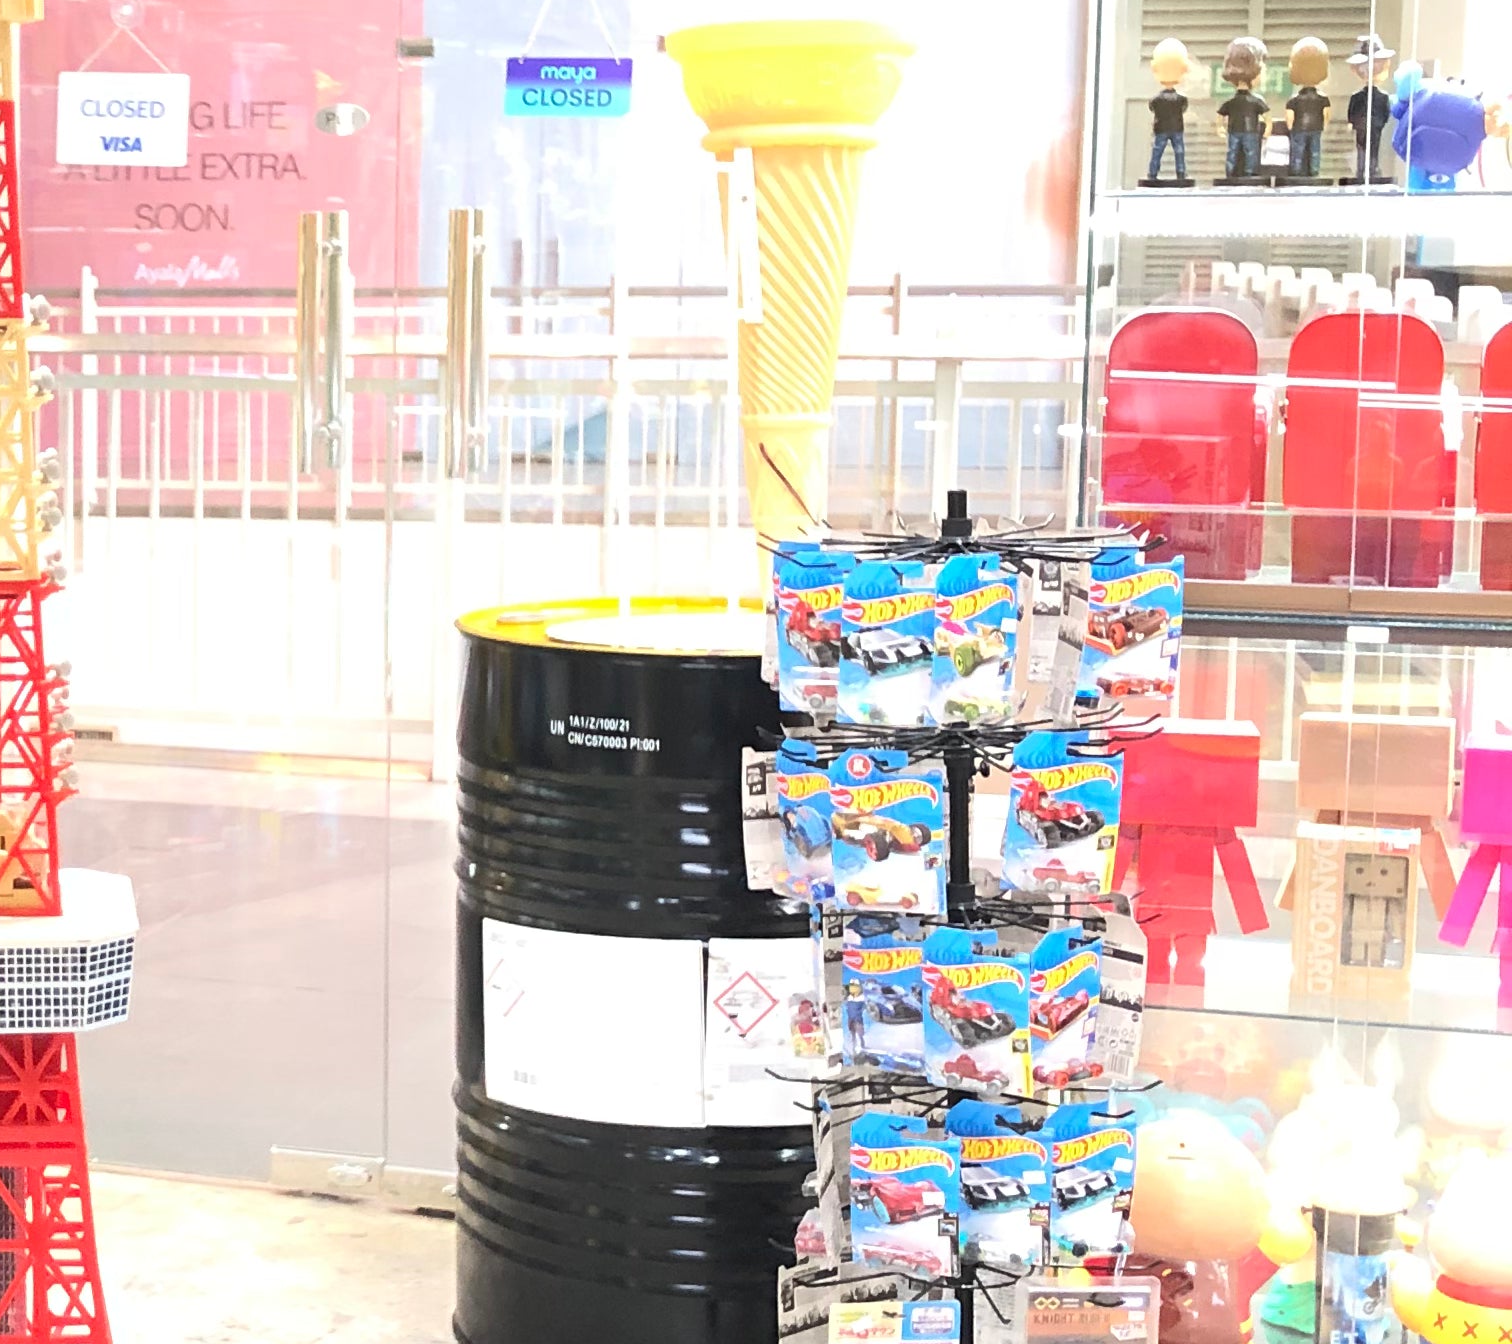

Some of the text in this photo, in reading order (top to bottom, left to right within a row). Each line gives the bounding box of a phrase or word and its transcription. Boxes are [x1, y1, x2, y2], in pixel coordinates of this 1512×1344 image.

[540, 65, 597, 85] maya
[80, 99, 166, 119] CLOSED
[521, 87, 613, 108] CLOSED
[223, 101, 287, 130] LIFE
[100, 136, 143, 153] VISA
[200, 152, 308, 181] EXTRA.
[134, 202, 236, 232] SOON.
[550, 719, 565, 735] UN
[881, 781, 931, 807] WHEELS
[1307, 839, 1339, 995] DANBOARD
